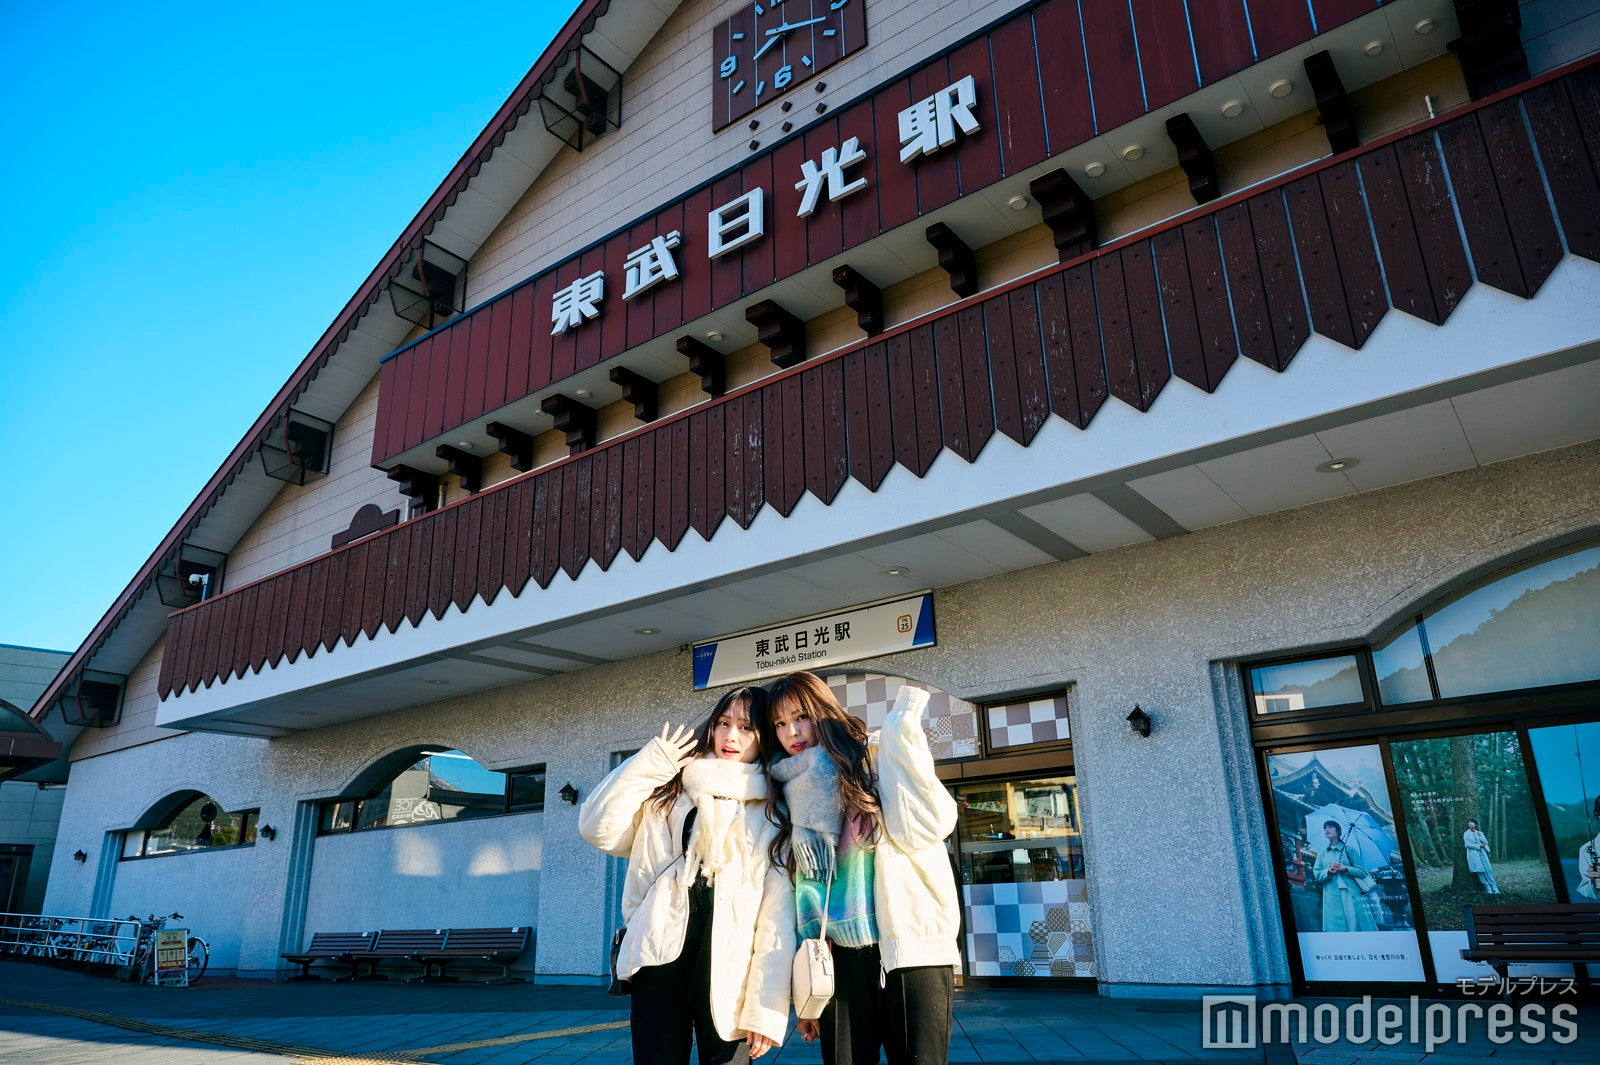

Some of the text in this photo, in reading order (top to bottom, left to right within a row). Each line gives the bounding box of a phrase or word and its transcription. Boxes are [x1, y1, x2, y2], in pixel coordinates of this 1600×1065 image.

[720, 55, 737, 78] 9
[774, 65, 792, 89] 6
[550, 74, 982, 337] 東武日光駅
[901, 622, 909, 630] 25
[755, 621, 851, 658] 東武日光駅
[798, 649, 827, 661] Station
